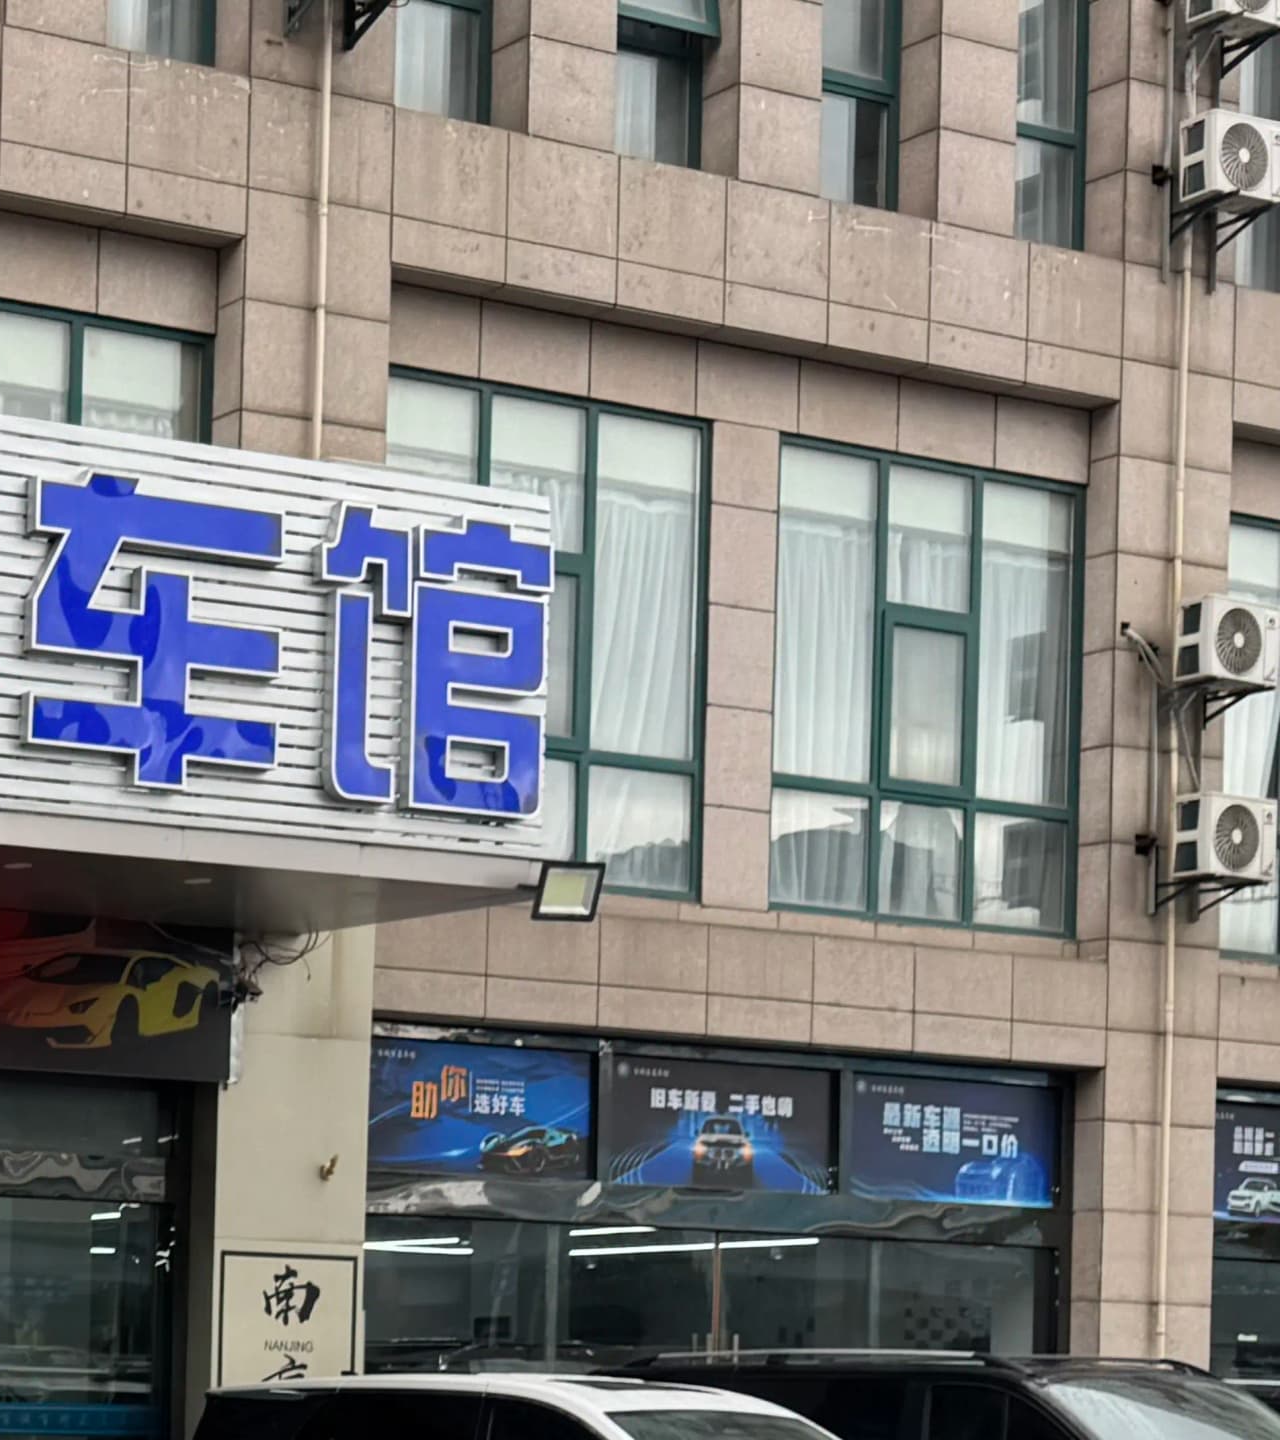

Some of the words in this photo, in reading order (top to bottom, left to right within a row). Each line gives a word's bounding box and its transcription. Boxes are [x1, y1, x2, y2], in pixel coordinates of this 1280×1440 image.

[473, 1093, 526, 1117] 选好车
[262, 1264, 320, 1326] 南
[263, 1339, 315, 1353] NANJING
